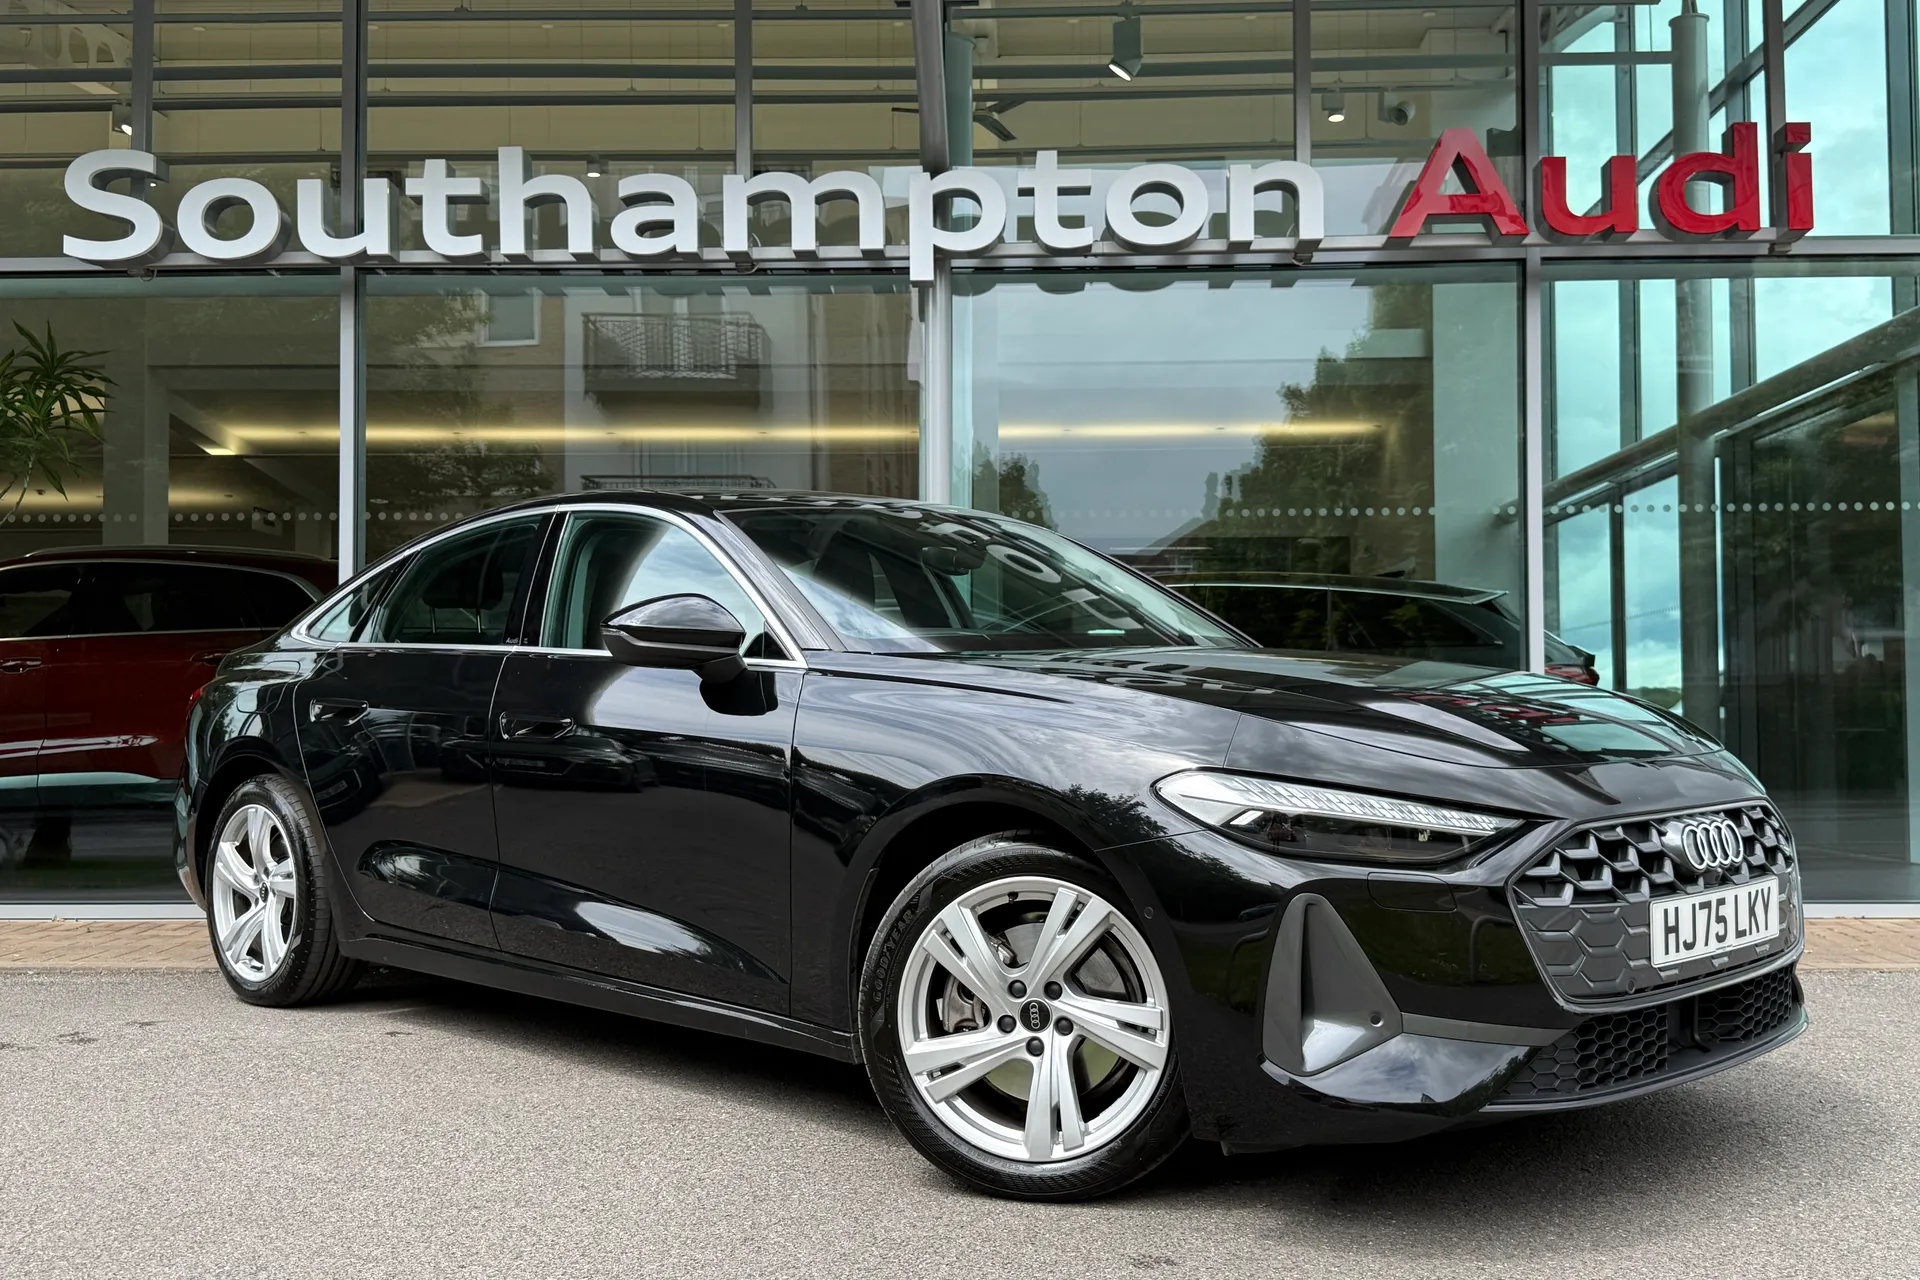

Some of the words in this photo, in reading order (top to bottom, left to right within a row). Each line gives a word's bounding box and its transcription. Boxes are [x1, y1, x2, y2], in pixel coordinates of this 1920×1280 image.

[62, 146, 1325, 284] Southampton
[1387, 121, 1815, 241] Audi
[872, 909, 914, 1003] GOODYEAR
[1663, 897, 1728, 956] HJ75
[1734, 886, 1771, 939] LKY
